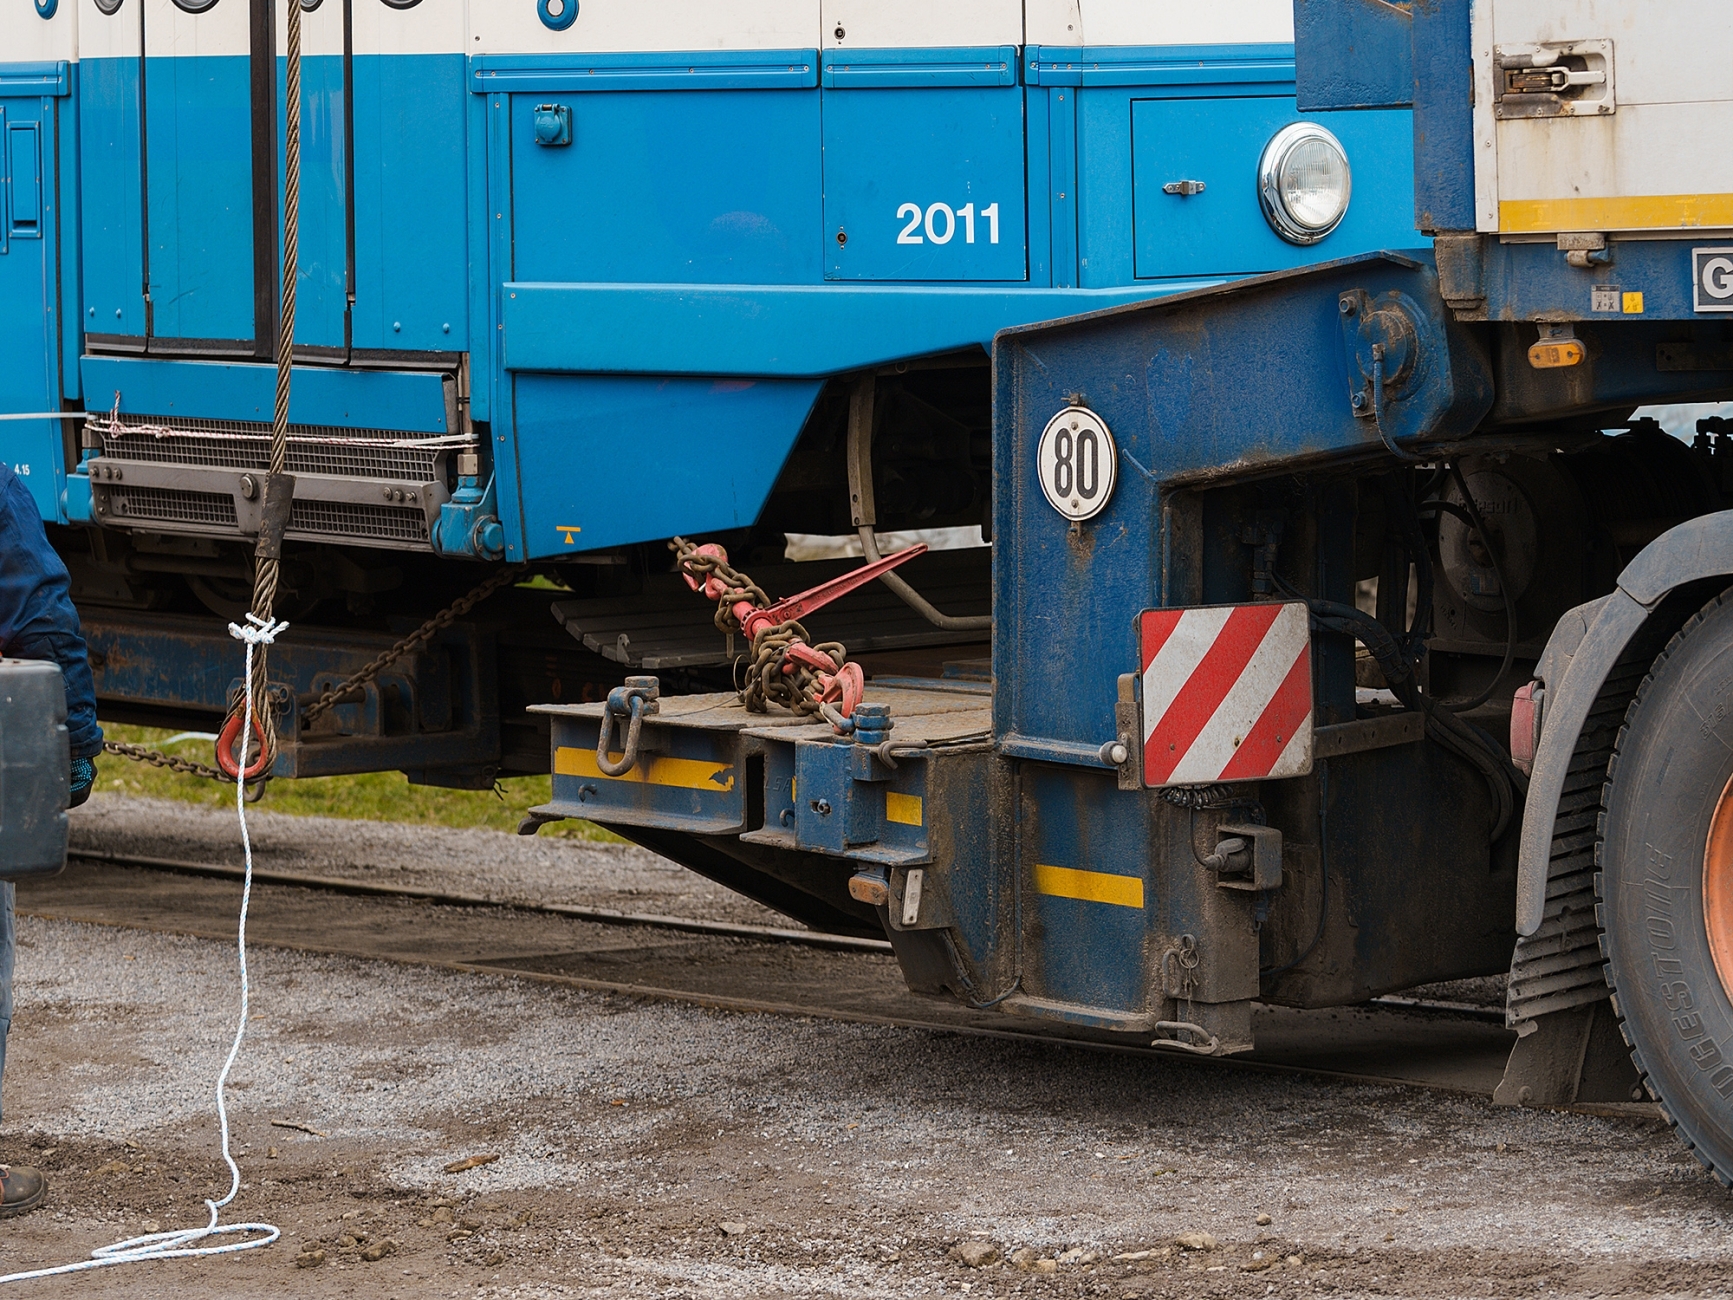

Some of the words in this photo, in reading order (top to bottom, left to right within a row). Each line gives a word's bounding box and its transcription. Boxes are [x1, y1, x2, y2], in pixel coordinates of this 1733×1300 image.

[896, 202, 999, 244] 2011
[1702, 257, 1733, 299] G
[1054, 427, 1099, 499] 80
[1645, 840, 1733, 1111] DGESTONE
